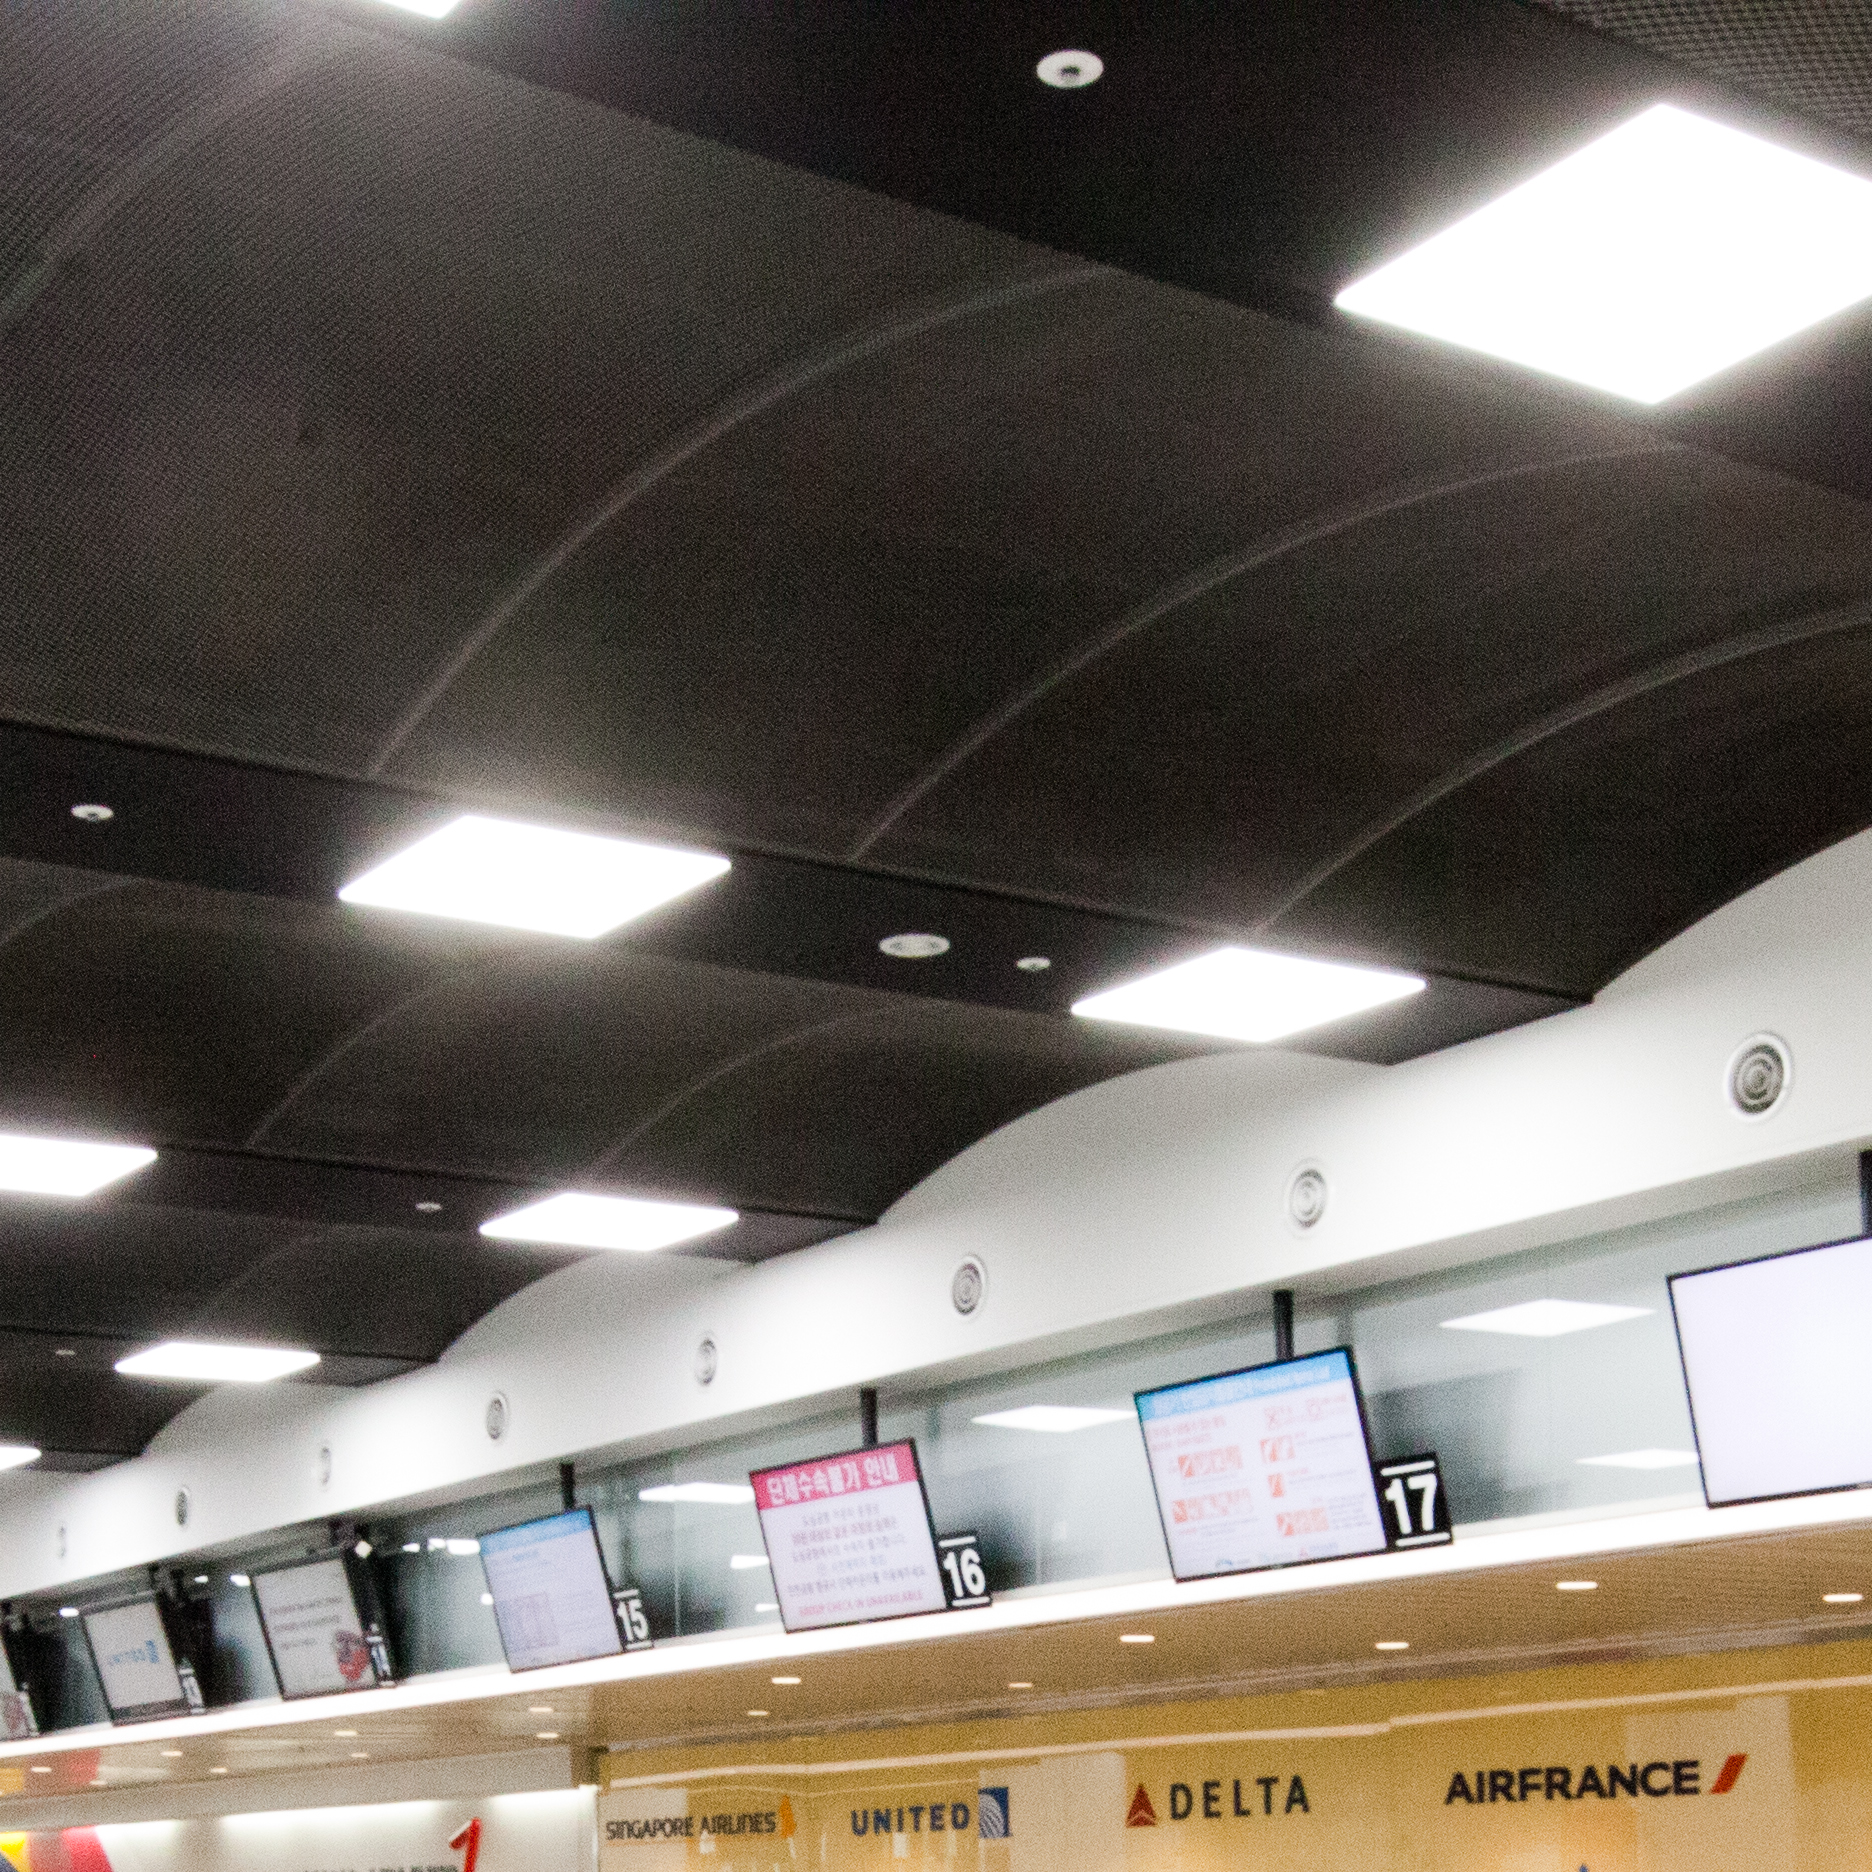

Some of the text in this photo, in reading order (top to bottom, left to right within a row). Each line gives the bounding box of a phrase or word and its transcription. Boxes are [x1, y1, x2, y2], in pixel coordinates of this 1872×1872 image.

[863, 1453, 900, 1486] 안내
[1385, 1473, 1437, 1535] 17
[943, 1548, 986, 1598] 16
[618, 1600, 649, 1642] 15
[1170, 1774, 1311, 1820] DELTA
[1445, 1760, 1701, 1805] AIRFRANCE
[605, 1810, 777, 1840] SINGAPORE AIRLINES
[851, 1803, 970, 1837] UNITED
